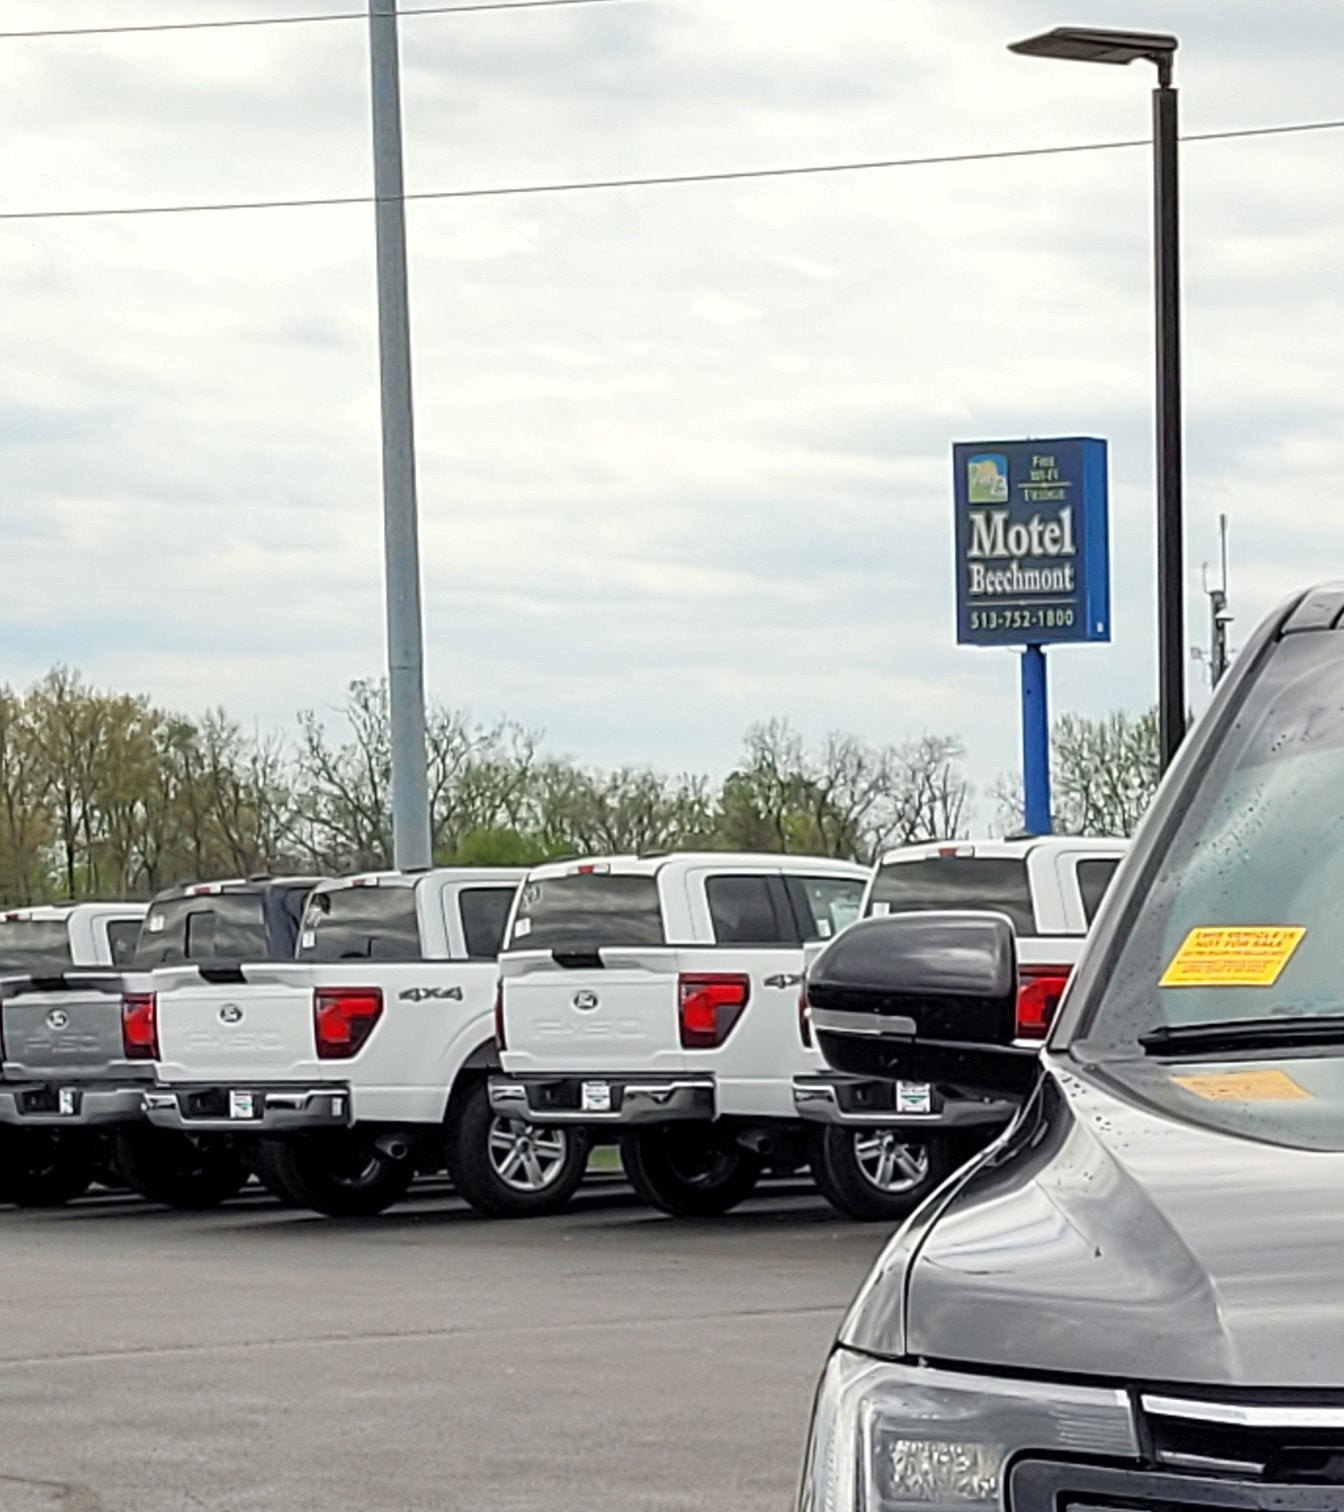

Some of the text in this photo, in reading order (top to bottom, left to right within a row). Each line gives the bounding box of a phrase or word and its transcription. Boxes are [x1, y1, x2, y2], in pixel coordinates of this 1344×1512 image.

[967, 505, 1076, 558] Motel
[969, 560, 1075, 595] Beechmont
[970, 609, 1074, 630] 513-752-1800
